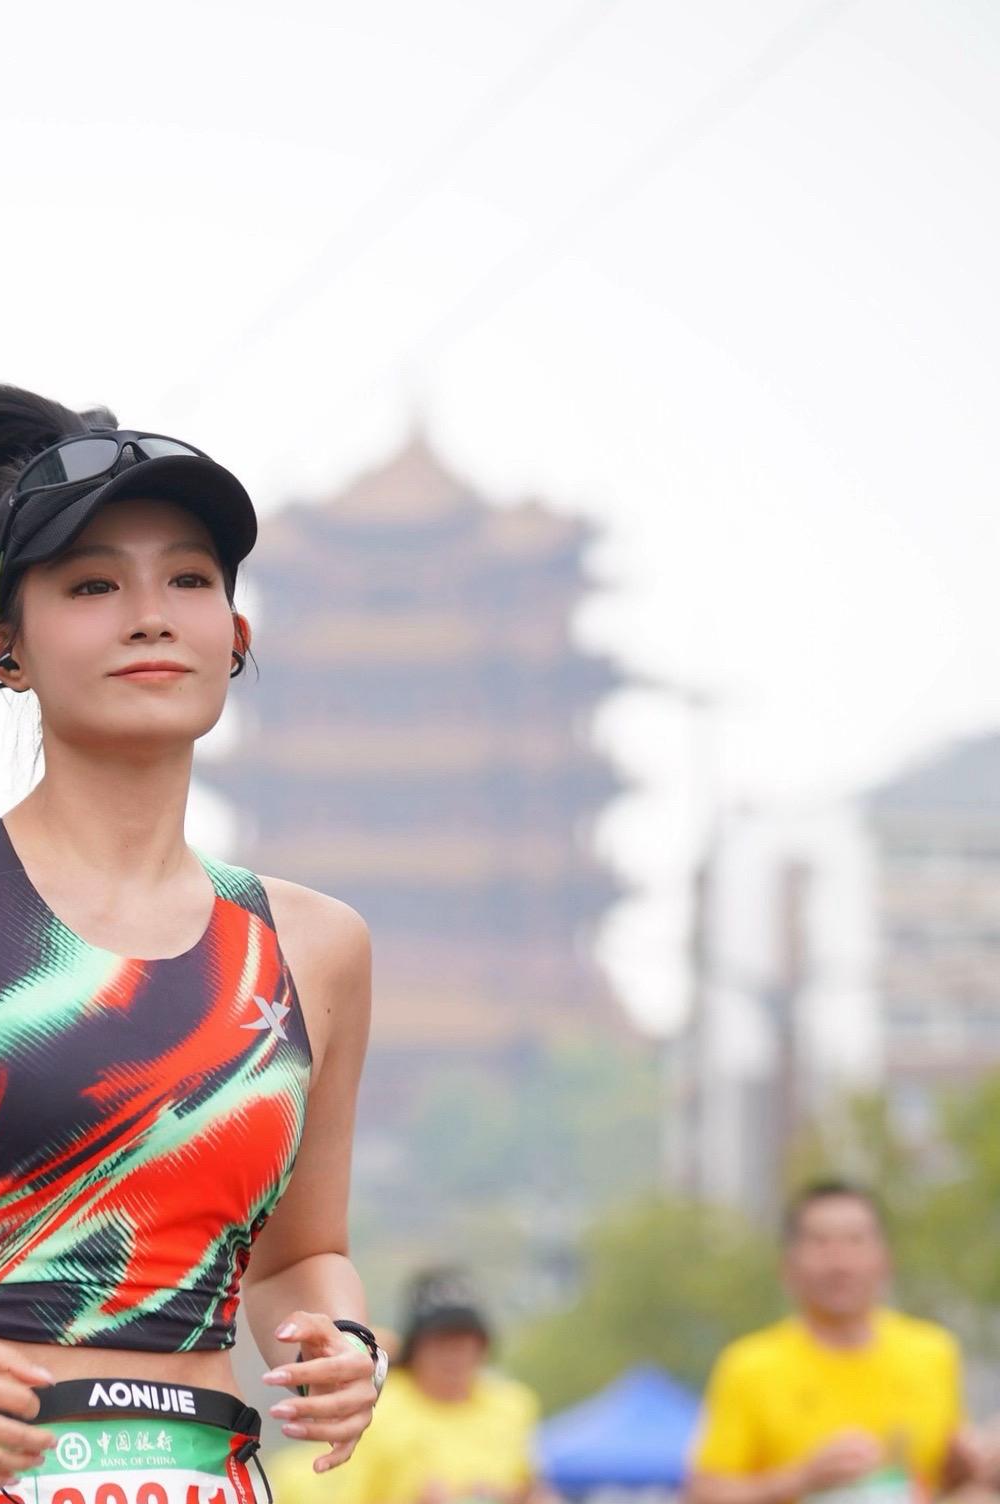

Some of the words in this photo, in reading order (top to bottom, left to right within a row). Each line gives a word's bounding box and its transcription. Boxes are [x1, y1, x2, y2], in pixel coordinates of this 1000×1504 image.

[88, 1382, 196, 1415] AONIJIE
[101, 1457, 127, 1466] BANK
[130, 1456, 144, 1466] OF
[147, 1455, 176, 1465] CHINA
